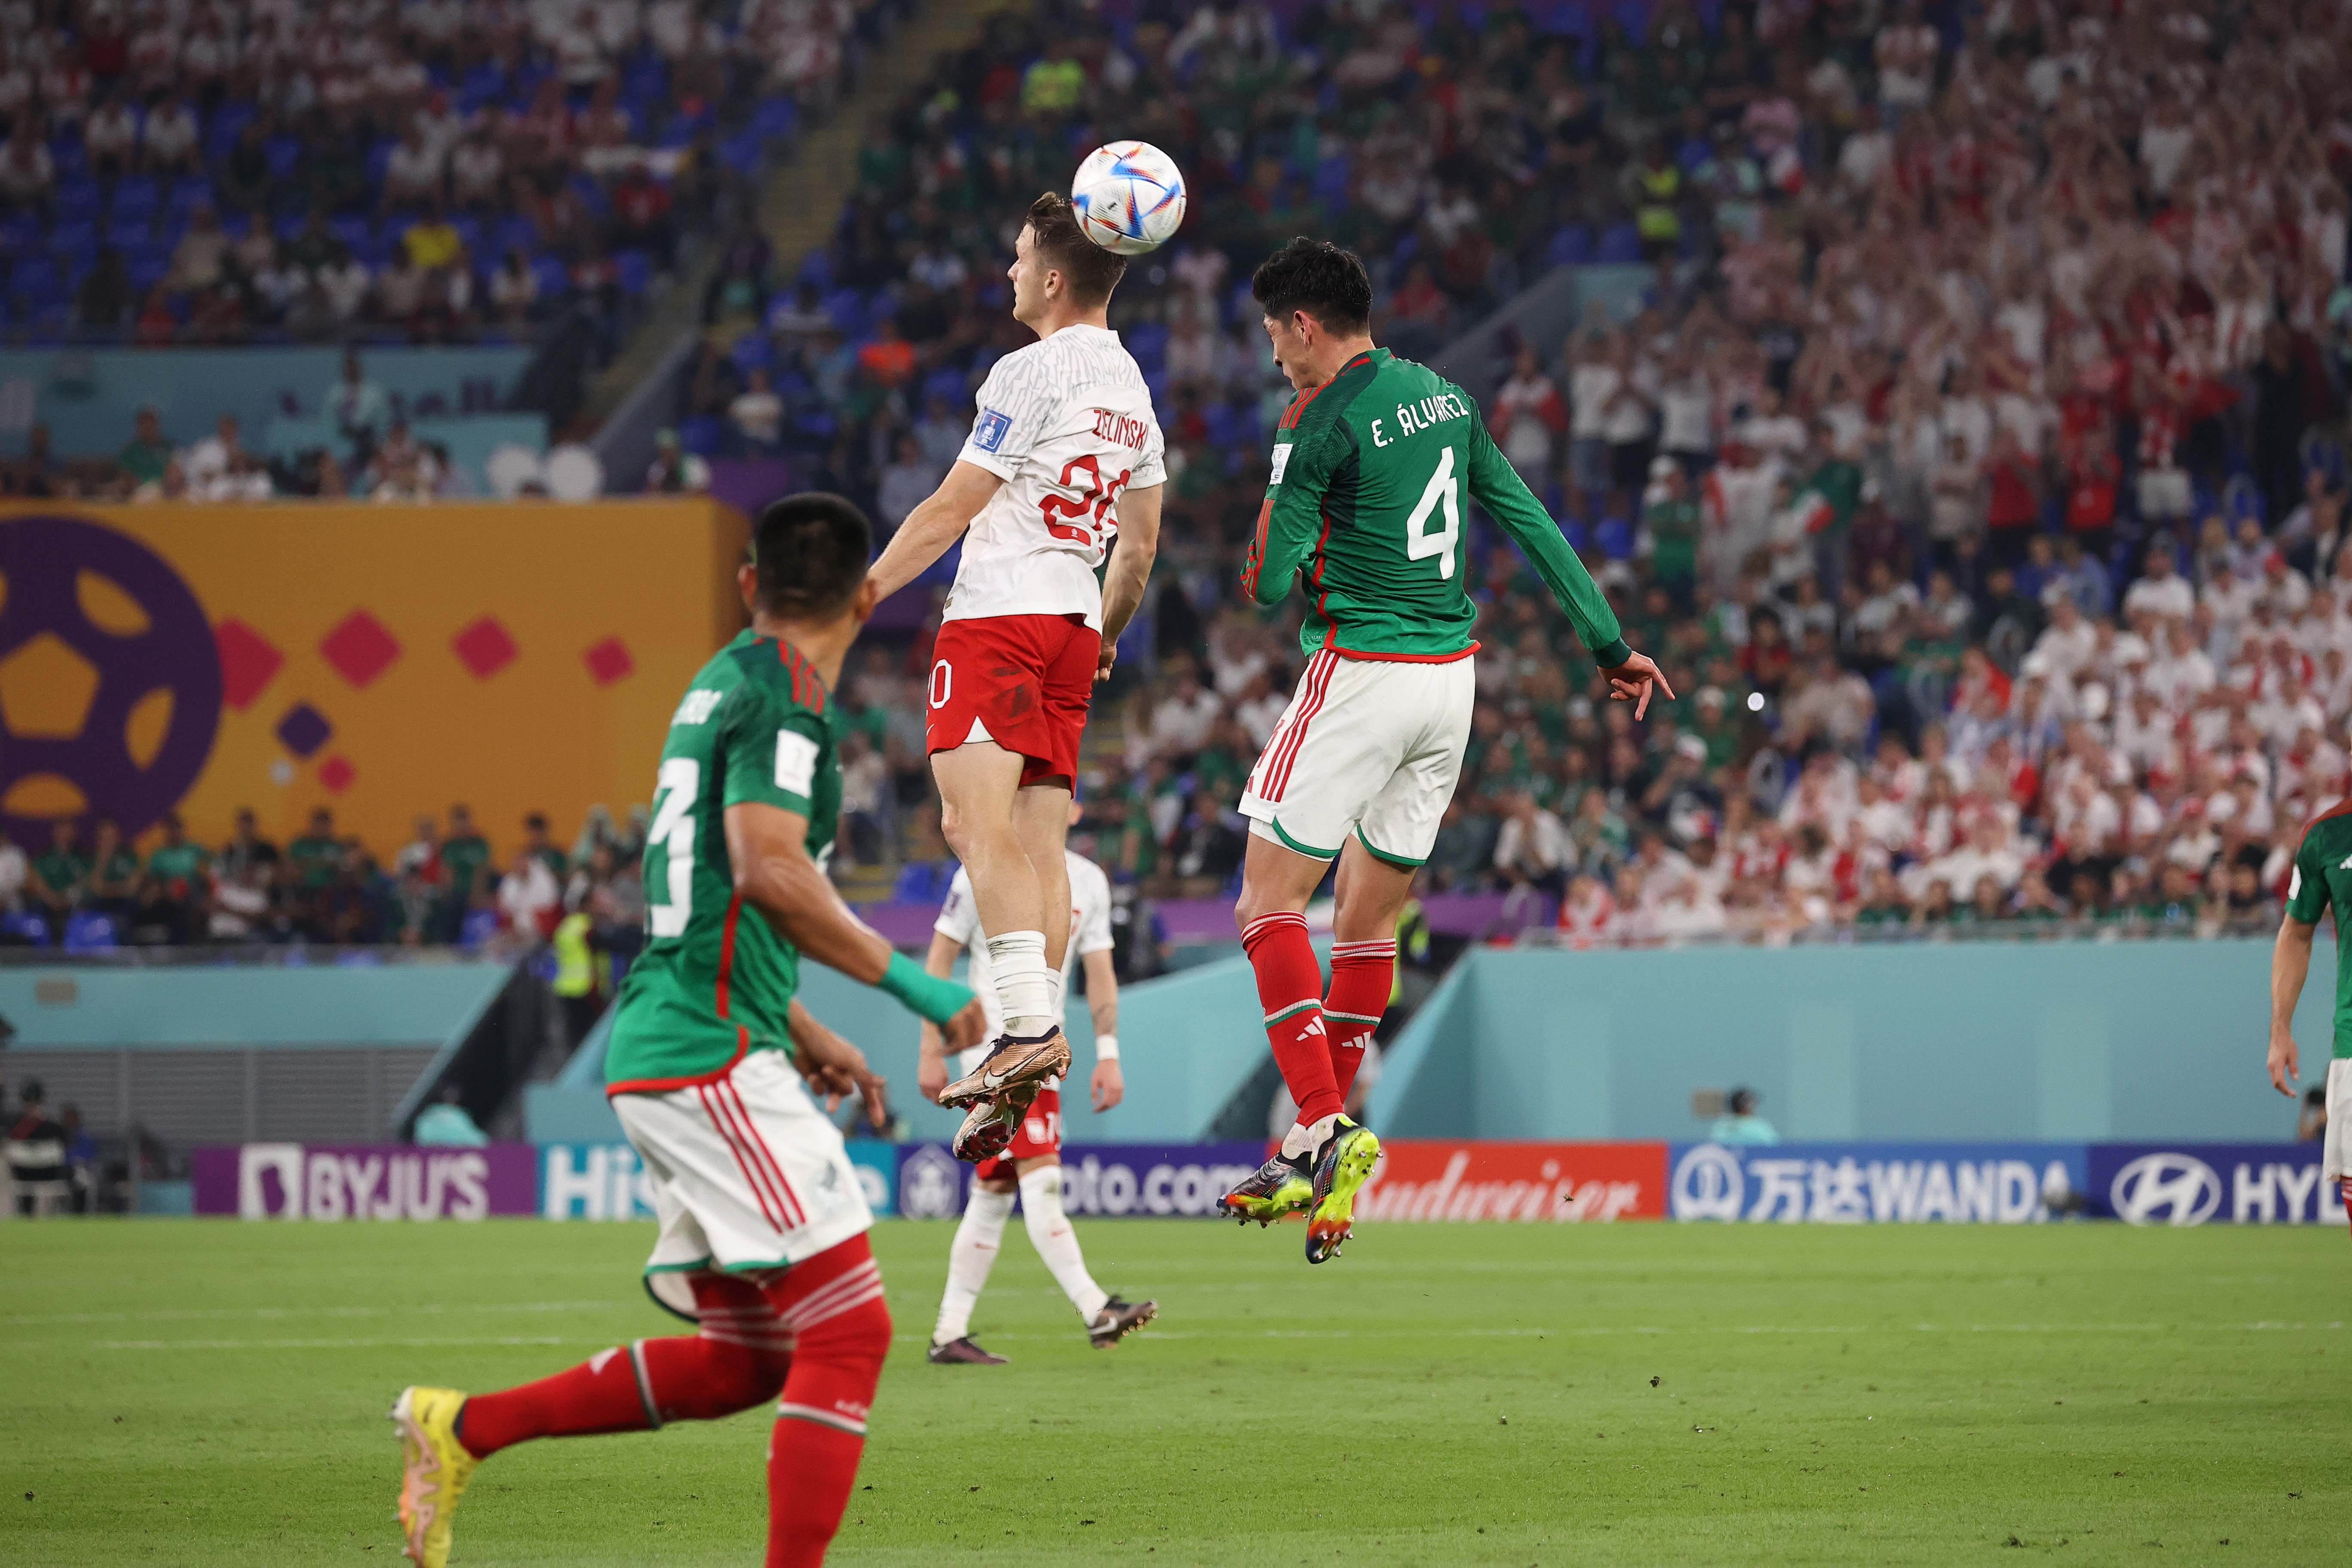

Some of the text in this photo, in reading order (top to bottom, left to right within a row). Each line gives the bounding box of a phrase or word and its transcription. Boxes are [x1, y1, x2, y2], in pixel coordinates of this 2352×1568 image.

[1371, 393, 1469, 447] E. ÁLVAREZ
[1406, 445, 1460, 580] 4
[645, 757, 700, 938] 3
[308, 1152, 490, 1222] BYJU'S
